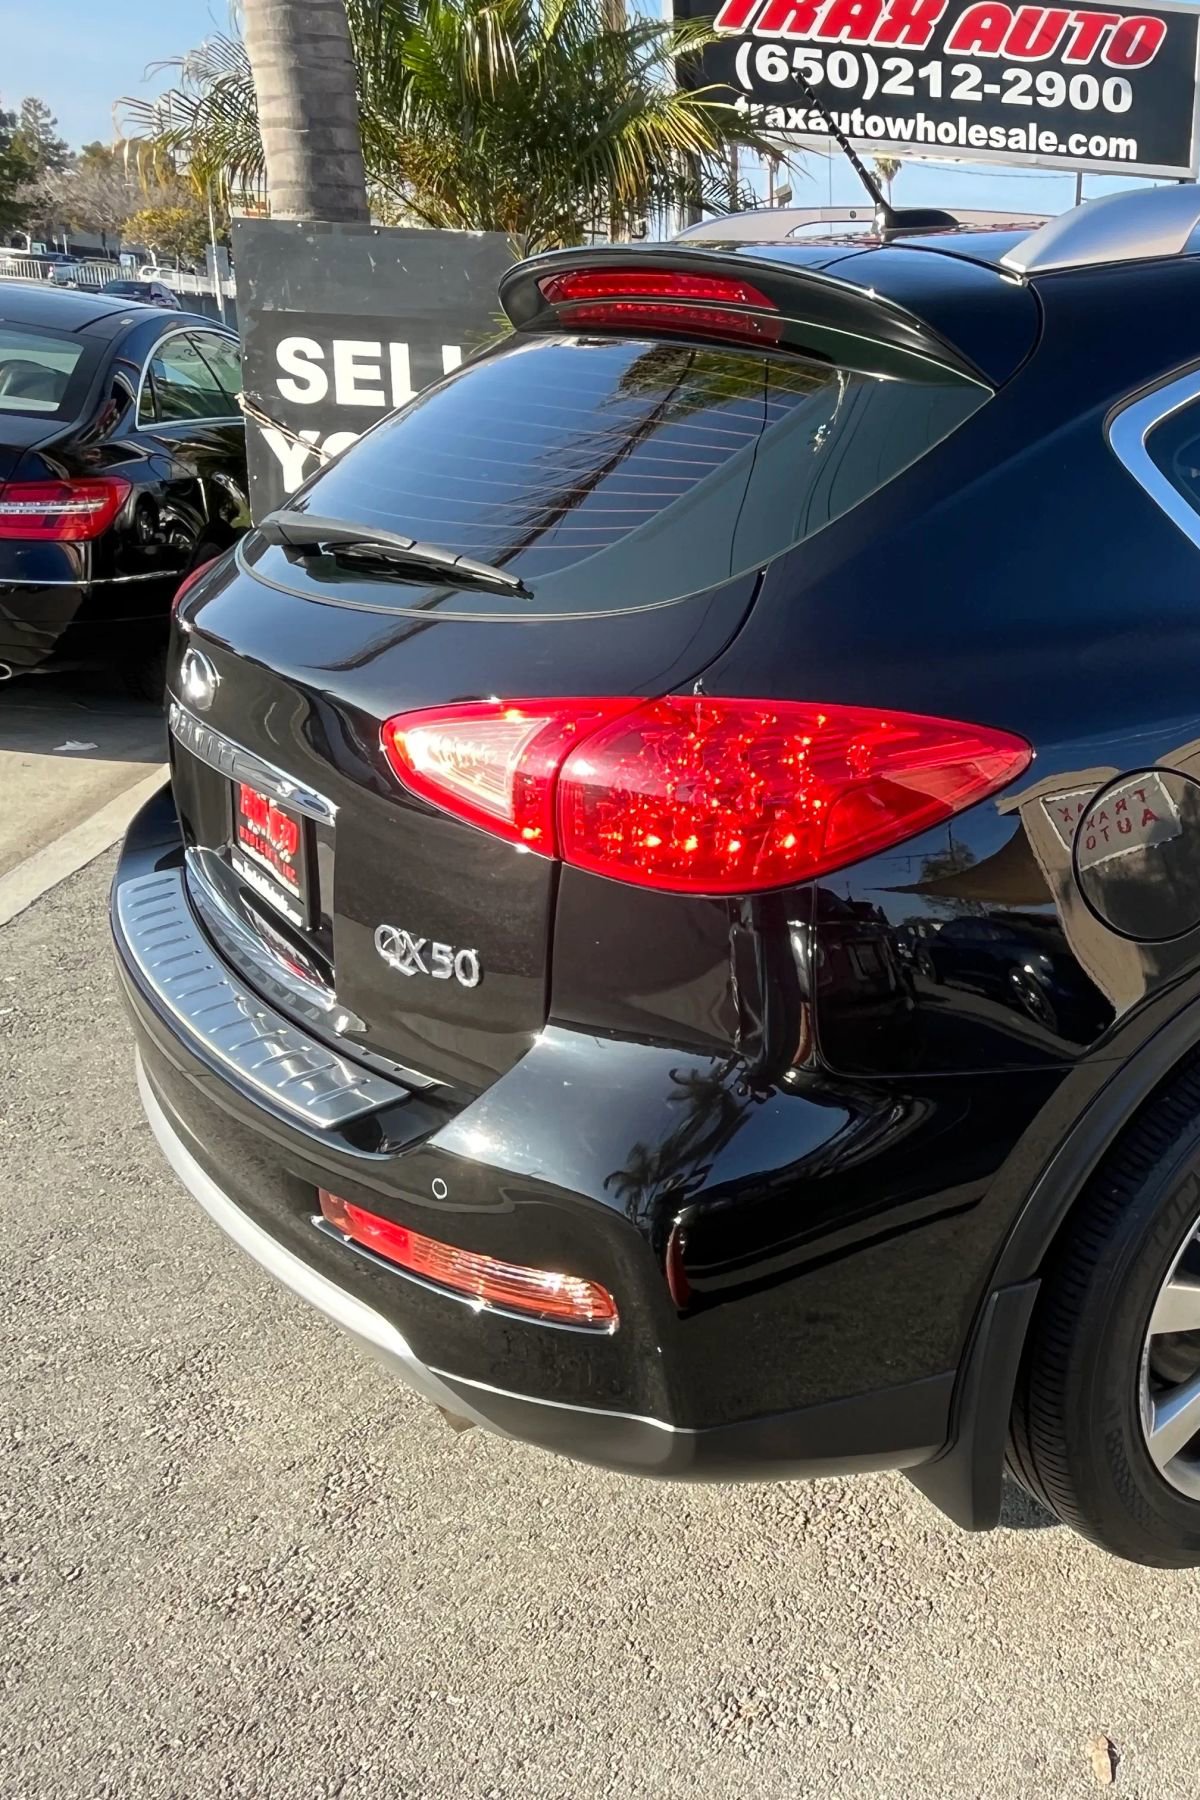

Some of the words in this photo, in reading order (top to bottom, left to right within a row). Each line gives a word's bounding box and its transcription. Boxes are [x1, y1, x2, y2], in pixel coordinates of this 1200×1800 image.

[943, 1, 1167, 70] AUTO
[735, 41, 1133, 113] (650)212-2900
[374, 924, 480, 988] QX50
